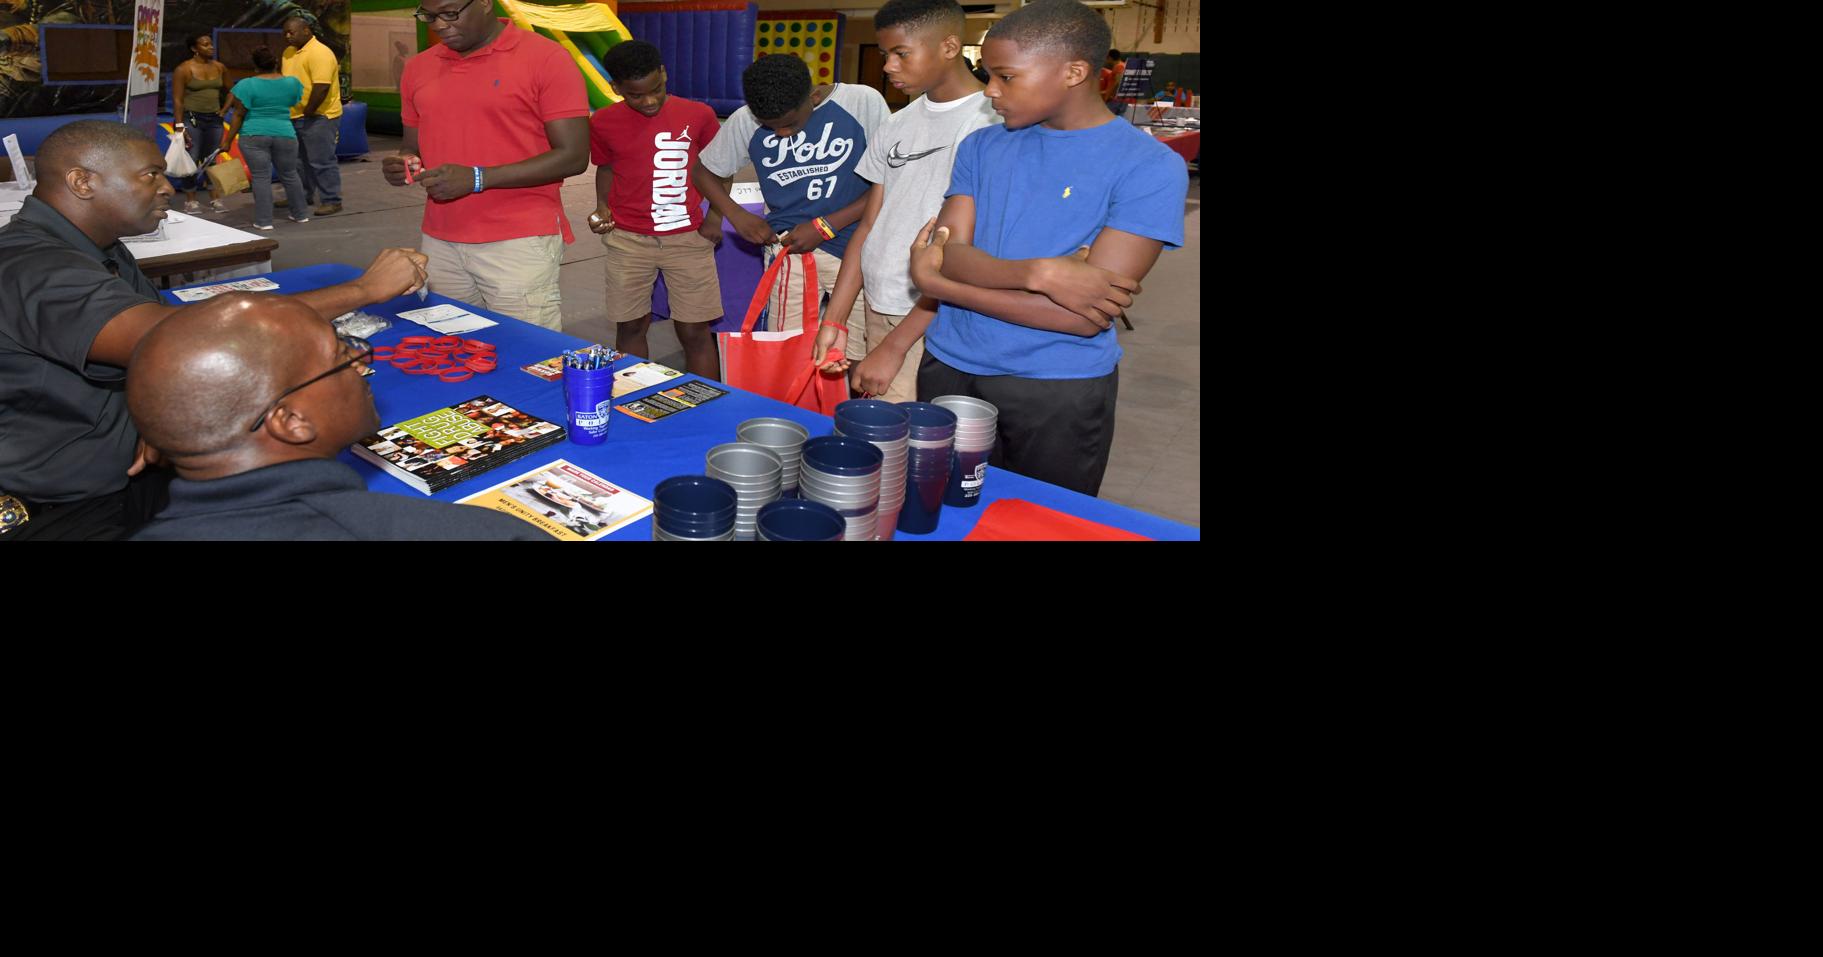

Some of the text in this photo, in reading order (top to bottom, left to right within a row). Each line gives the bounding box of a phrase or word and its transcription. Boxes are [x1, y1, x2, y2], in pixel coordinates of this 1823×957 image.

[761, 121, 853, 168] Polo
[650, 132, 692, 232] JORDAN
[777, 165, 829, 182] ESTABLISHED
[806, 175, 838, 201] 67
[403, 422, 455, 446] FIGHT
[422, 415, 472, 440] DRUG
[531, 516, 567, 537] BREAKFAST
